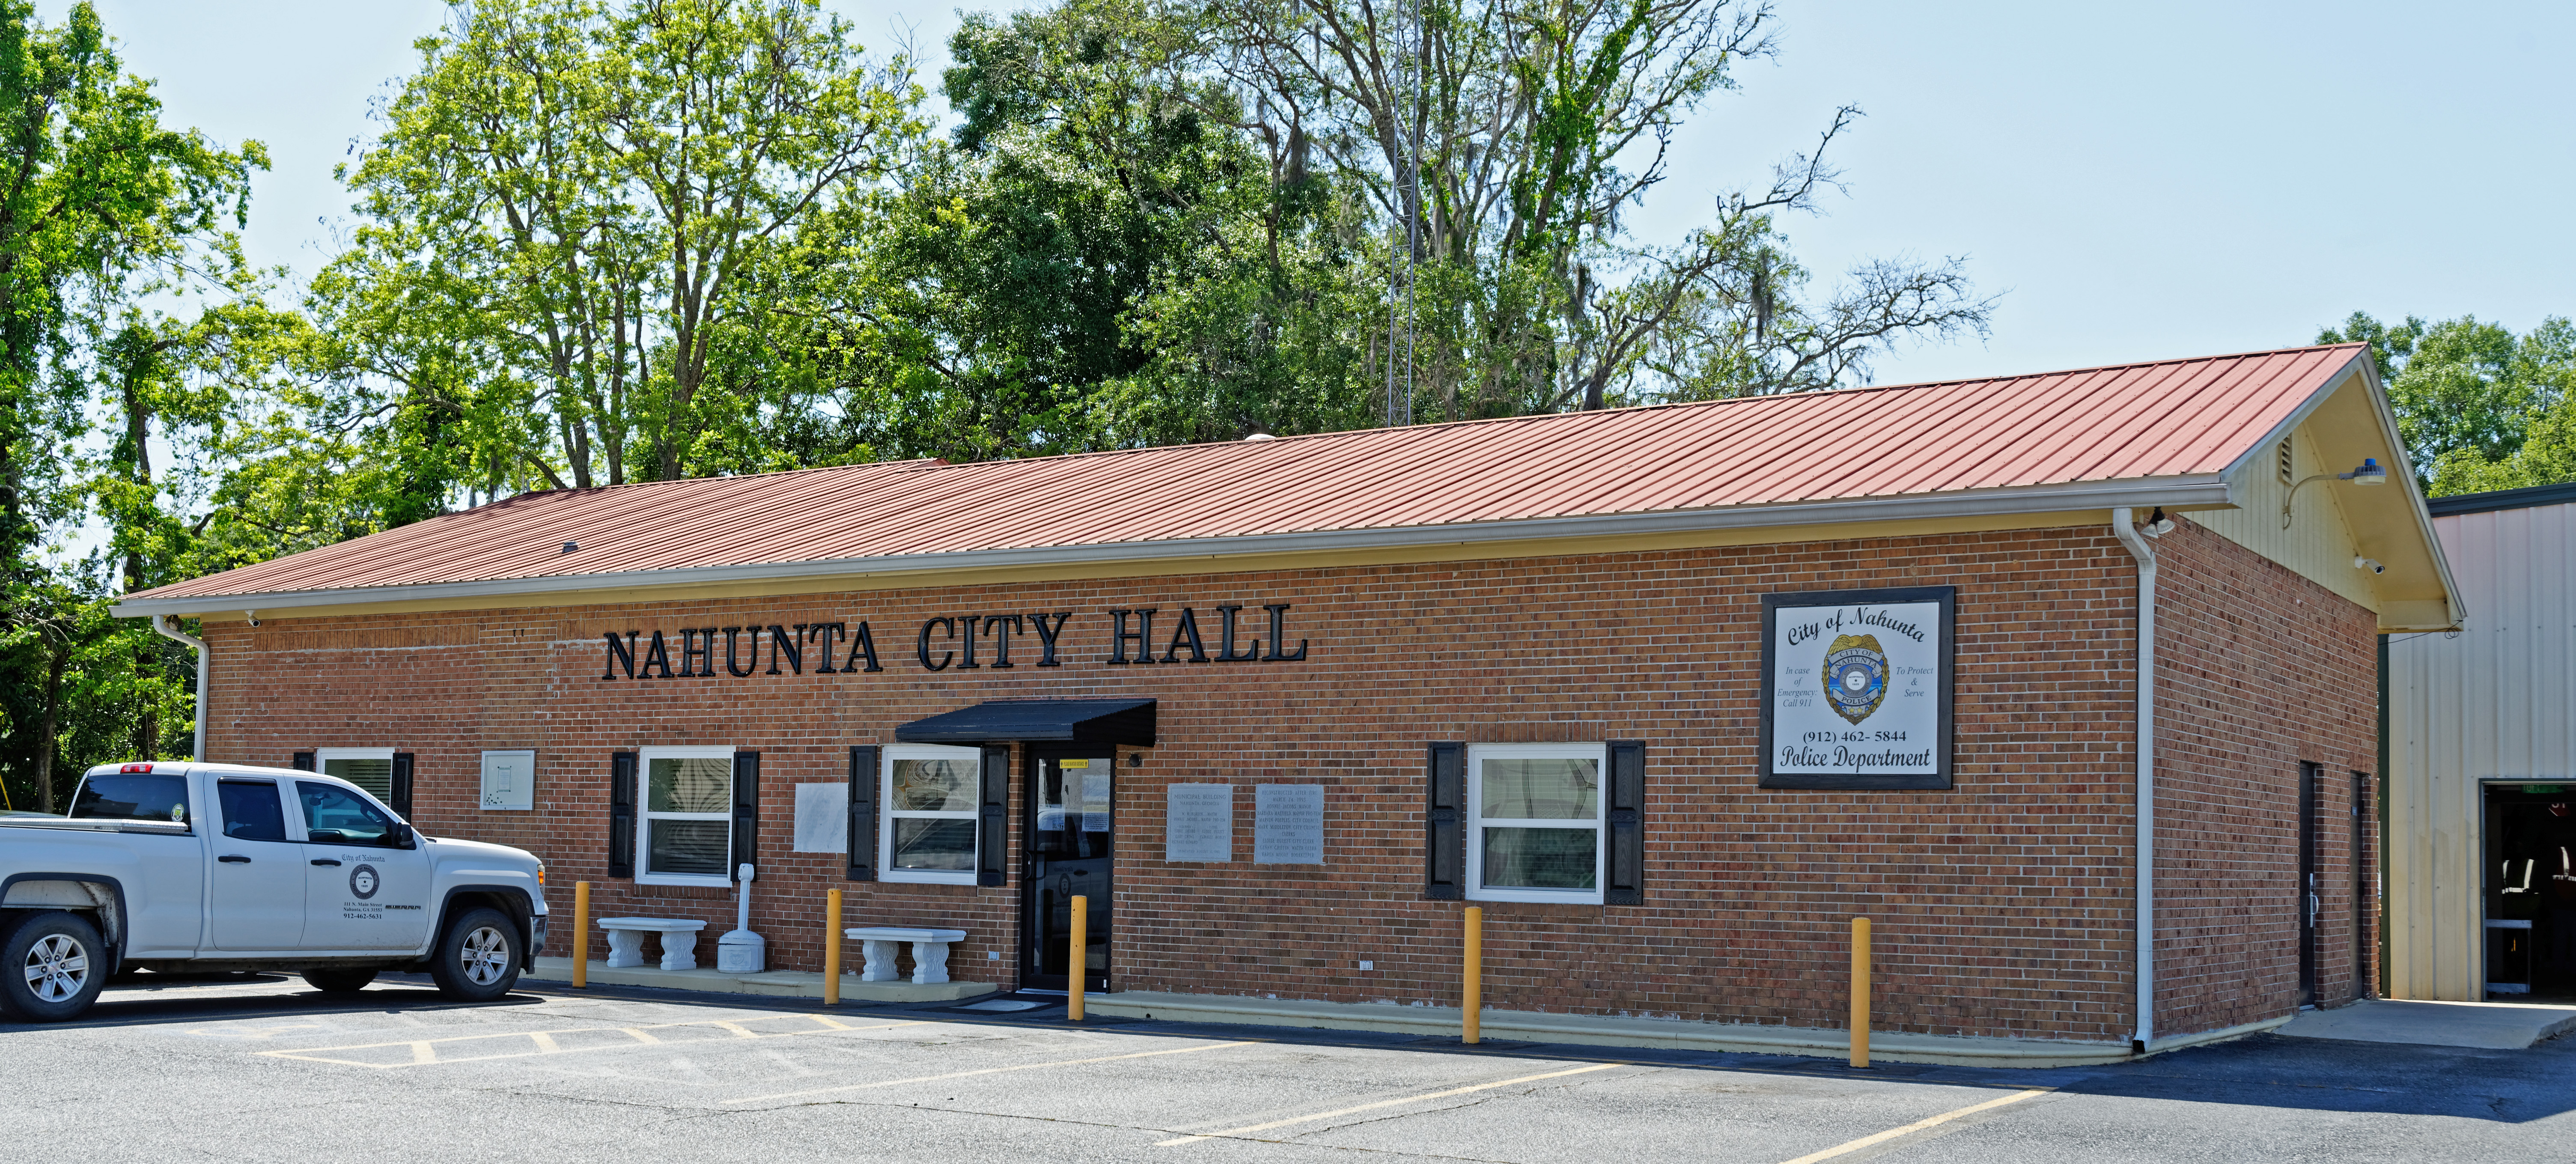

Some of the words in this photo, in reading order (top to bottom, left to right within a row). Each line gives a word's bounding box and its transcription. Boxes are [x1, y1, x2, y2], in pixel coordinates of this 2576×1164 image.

[1788, 622, 1821, 646] City
[1826, 609, 1844, 633] of
[1849, 607, 1925, 643] Nahunta
[602, 621, 883, 680] NAHUNTA
[918, 611, 1072, 671] CITY
[1107, 604, 1308, 664] HALL
[1840, 649, 1860, 657] CITY
[1835, 657, 1877, 669] NAHUNTA
[1794, 677, 1803, 687] of
[1911, 678, 1918, 686] &
[1777, 688, 1818, 698] Emergency:
[1904, 689, 1924, 697] Serve
[1783, 699, 1798, 707] Call
[1841, 695, 1871, 704] POLICE
[1803, 731, 1837, 744] (912)
[1841, 731, 1870, 741] 462-
[1875, 731, 1906, 741] 5844
[1780, 745, 1828, 766] Police
[1833, 745, 1931, 773] Department
[342, 854, 354, 862] City
[362, 854, 385, 863] Nahunta
